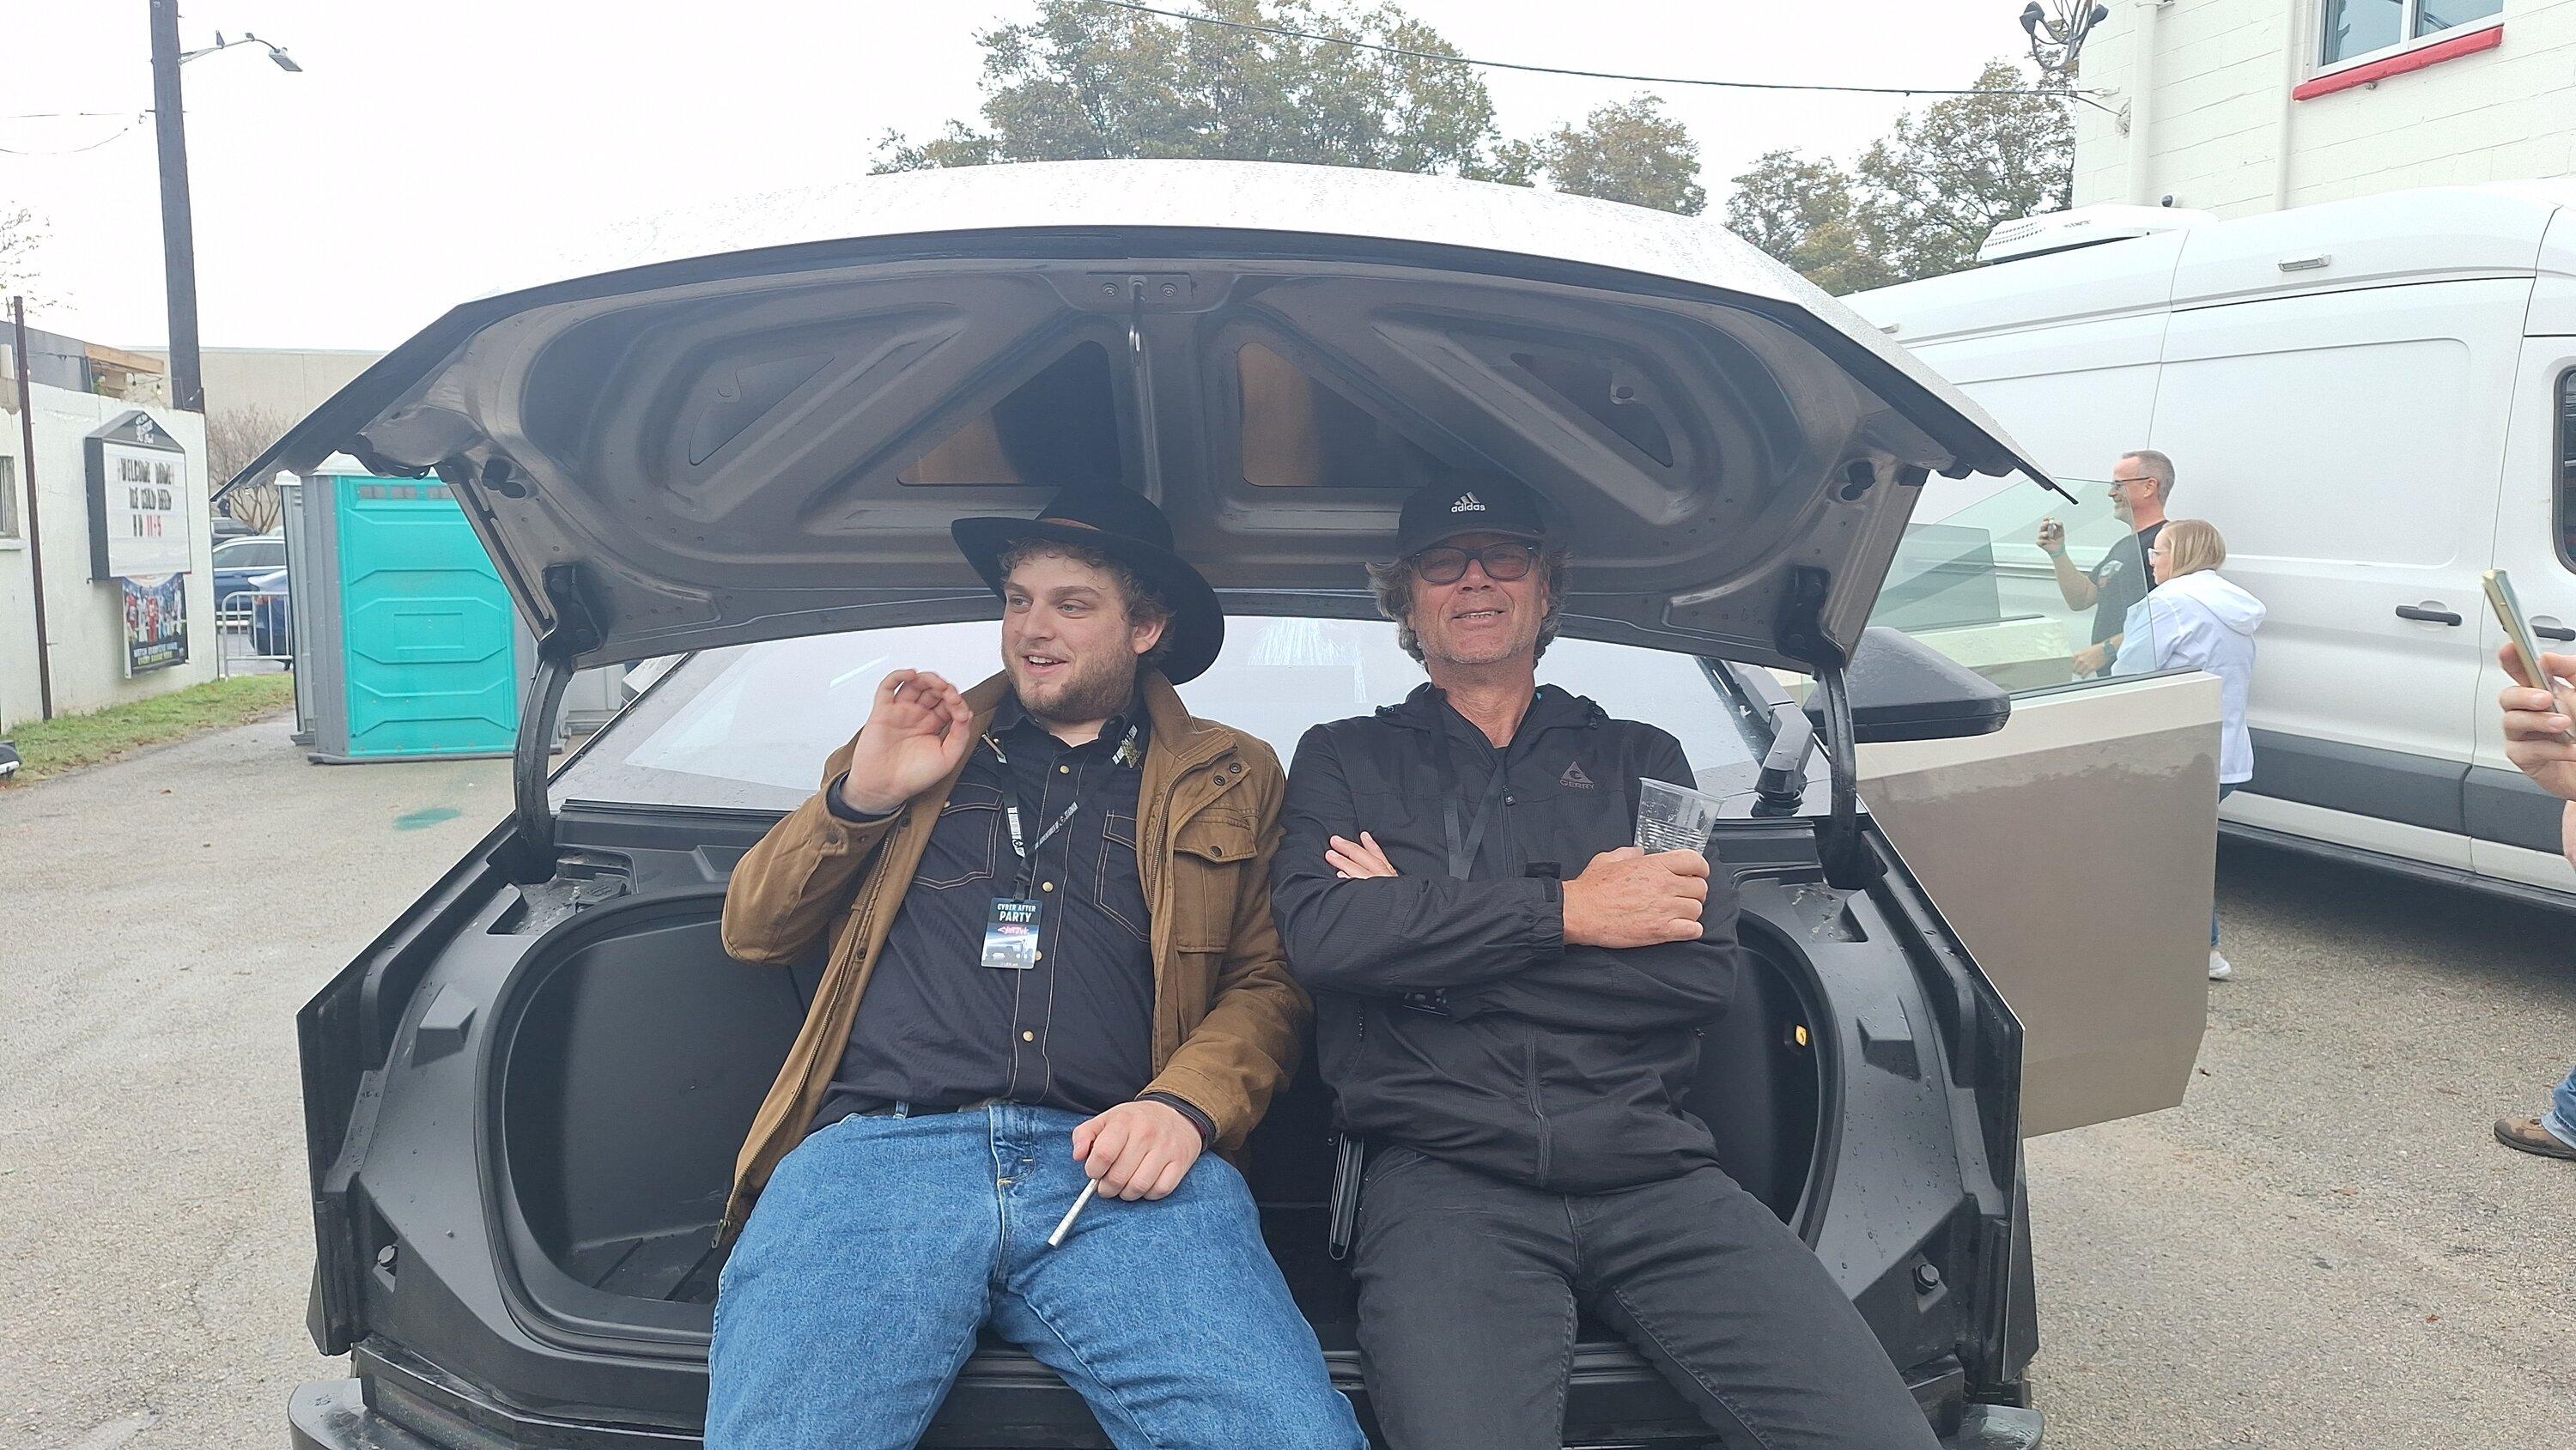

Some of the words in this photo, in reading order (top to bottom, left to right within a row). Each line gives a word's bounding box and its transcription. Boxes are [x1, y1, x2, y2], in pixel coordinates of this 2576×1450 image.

[1451, 502, 1485, 513] adidas
[1559, 780, 1595, 790] GERRY
[997, 903, 1017, 912] CYBER
[1017, 904, 1036, 913] AFTER
[999, 911, 1032, 923] PARTY
